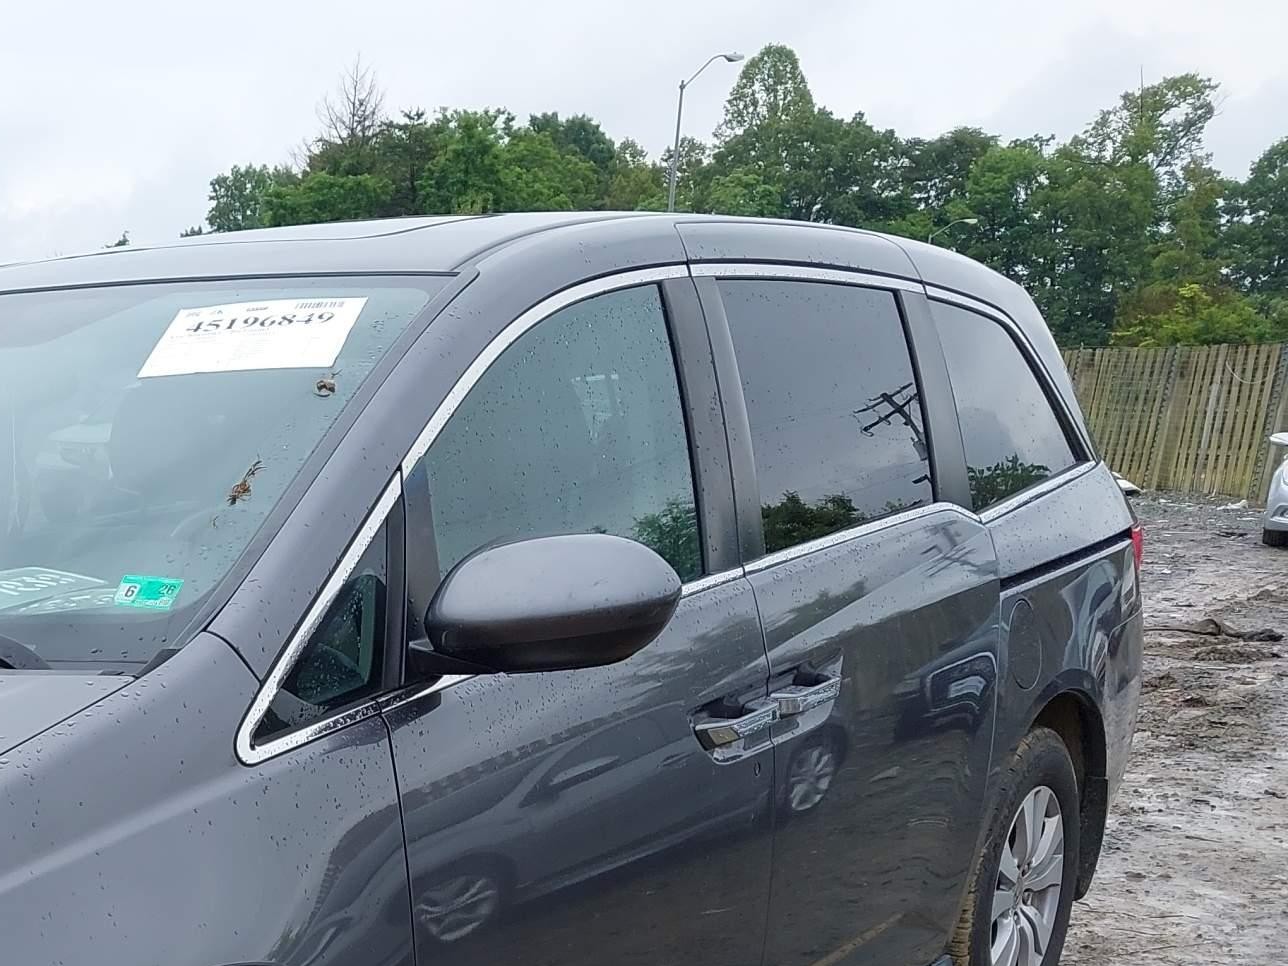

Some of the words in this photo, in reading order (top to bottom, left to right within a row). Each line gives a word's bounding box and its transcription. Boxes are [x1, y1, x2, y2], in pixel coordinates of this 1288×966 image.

[186, 311, 335, 333] 45196849
[124, 585, 138, 598] 6
[158, 583, 177, 597] 26
